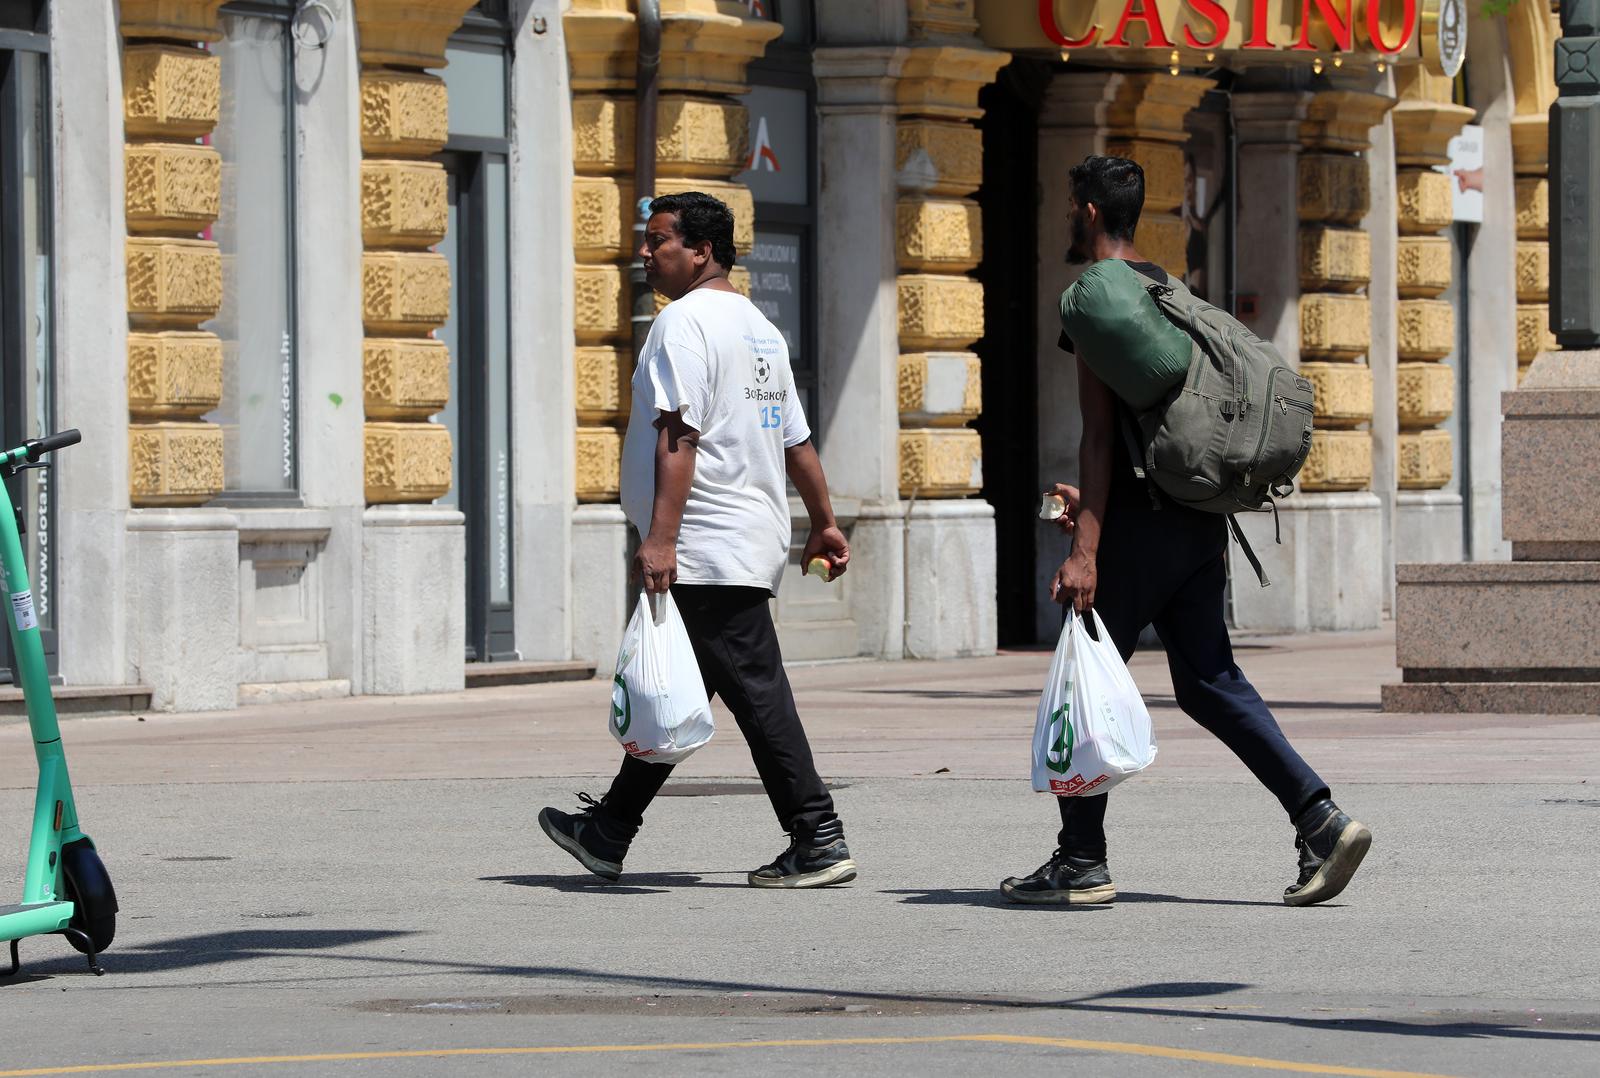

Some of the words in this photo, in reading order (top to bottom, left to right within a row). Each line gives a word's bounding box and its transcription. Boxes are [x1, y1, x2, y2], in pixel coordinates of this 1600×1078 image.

[1037, 0, 1414, 55] CASINO
[280, 330, 291, 478] www.dota.hr
[761, 406, 781, 428] 15
[37, 467, 48, 616] www.dota.h
[496, 450, 507, 589] www.dota.hr
